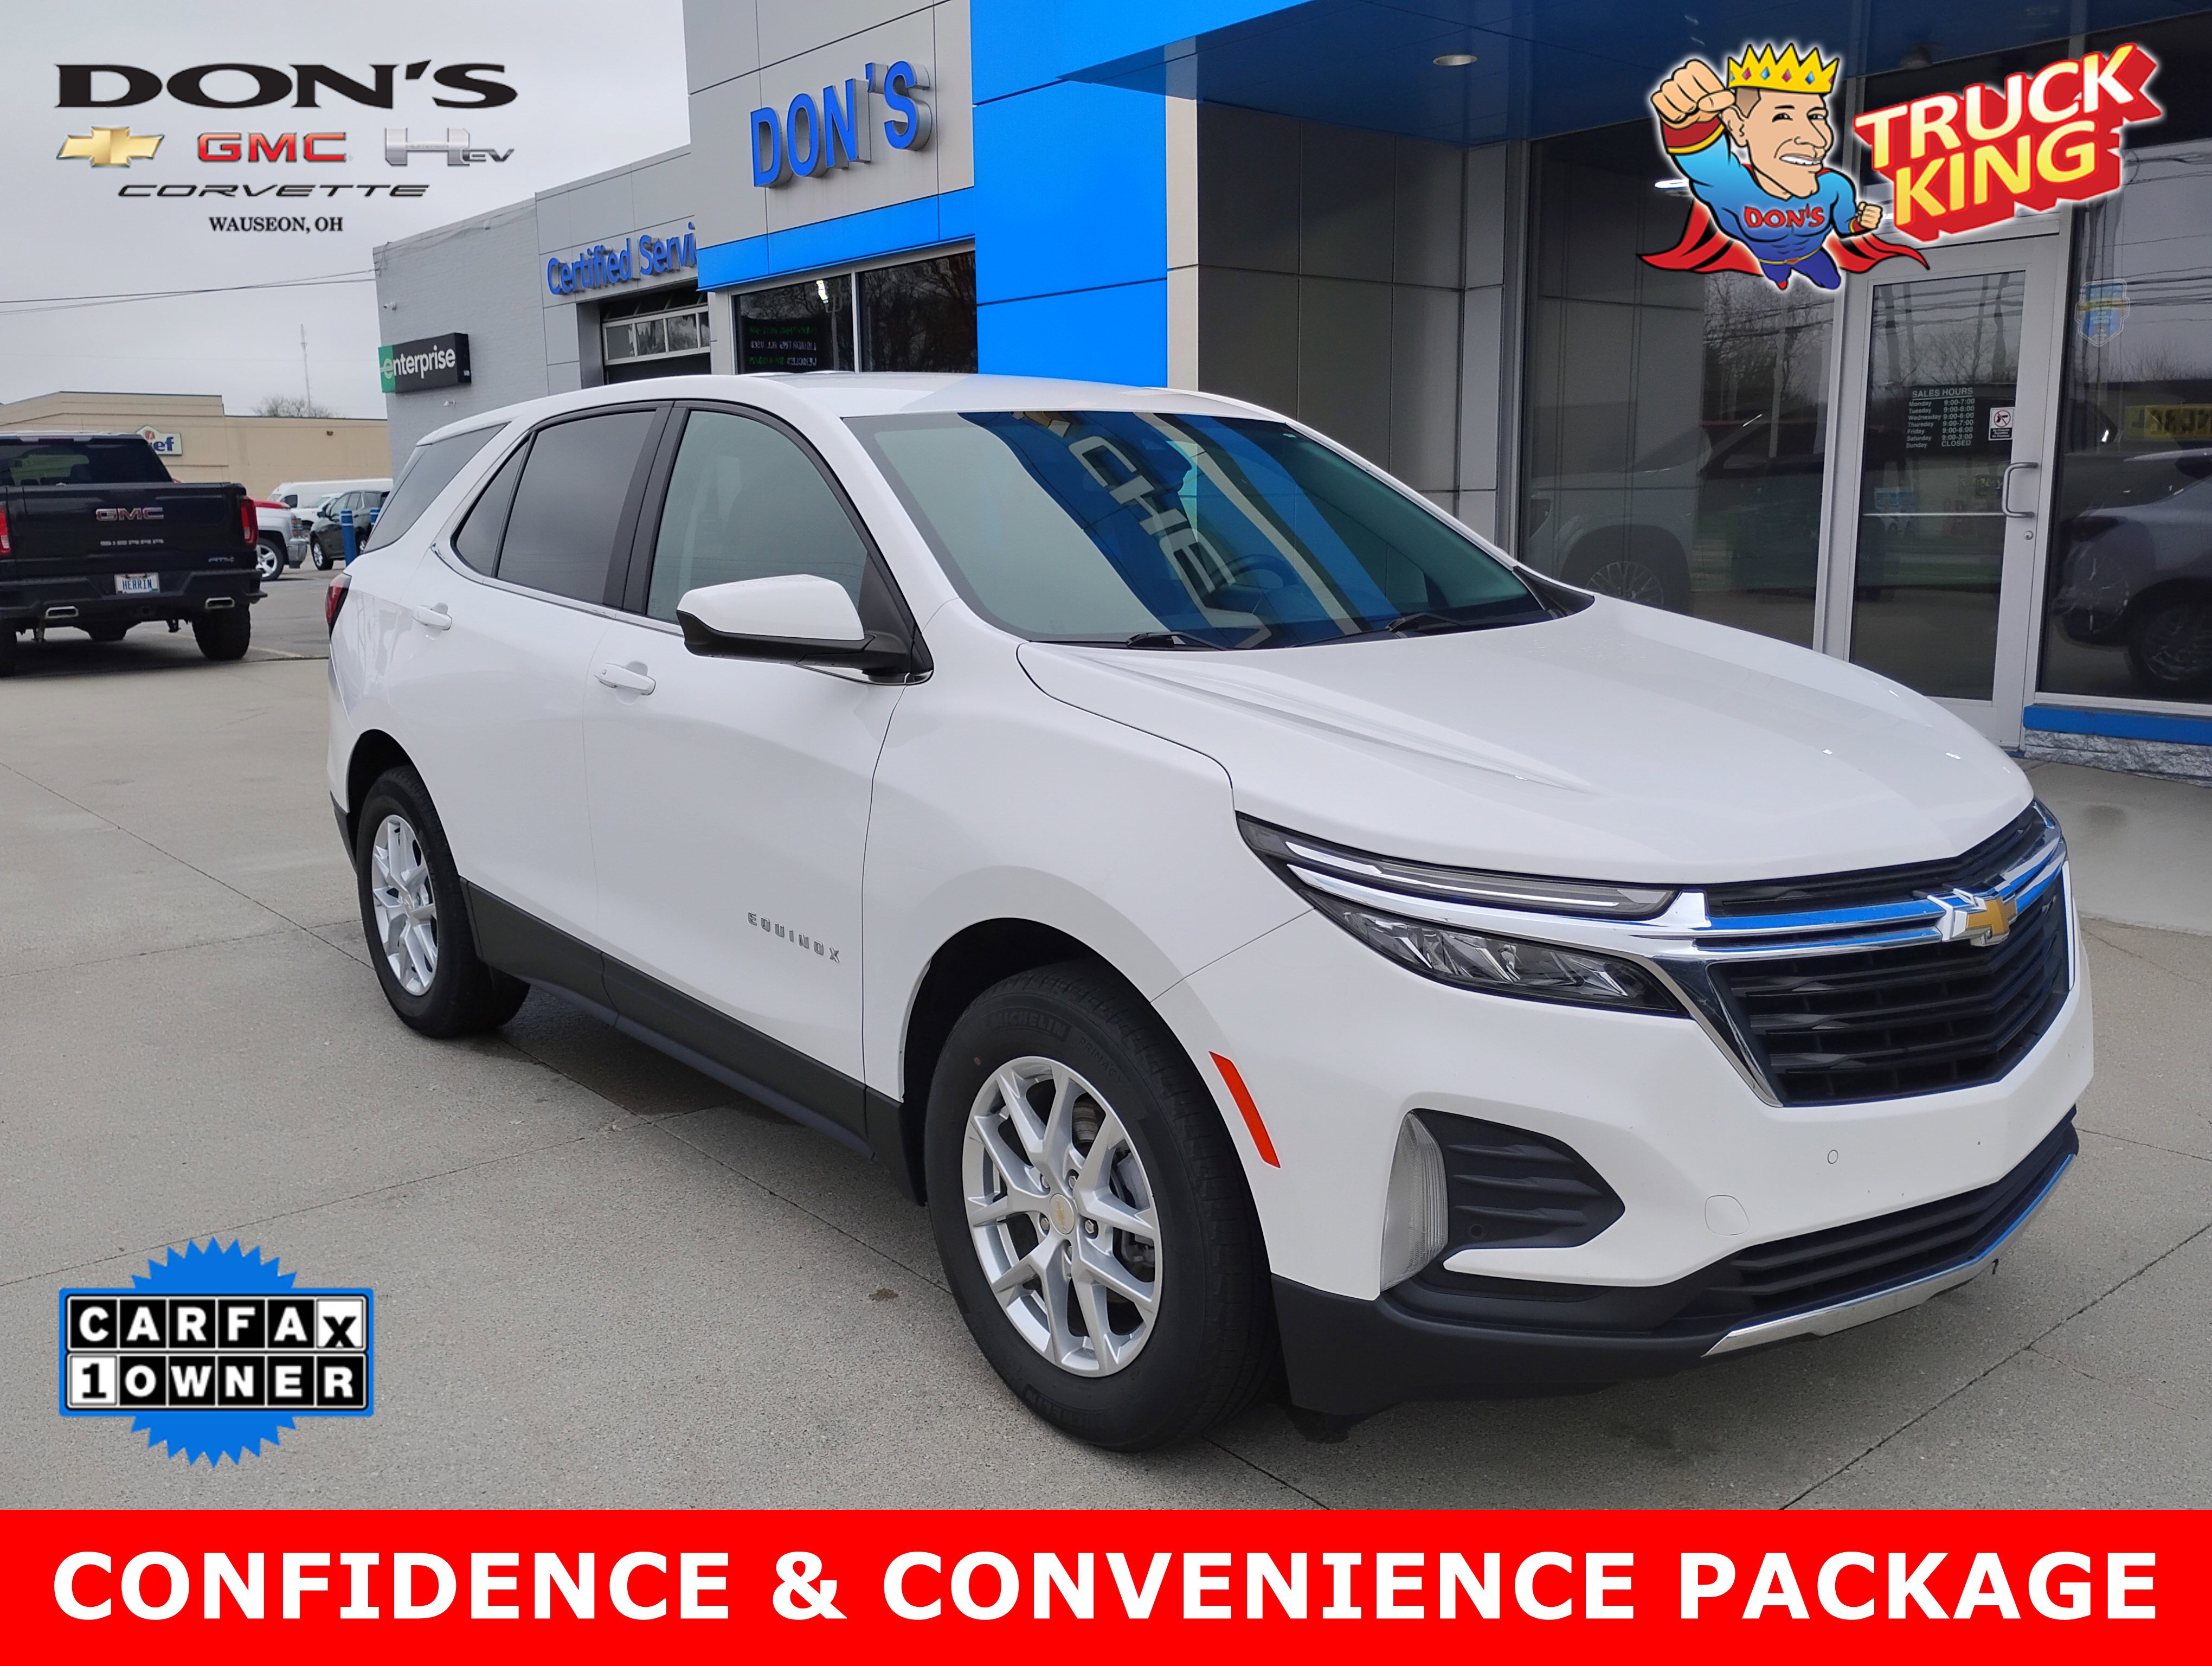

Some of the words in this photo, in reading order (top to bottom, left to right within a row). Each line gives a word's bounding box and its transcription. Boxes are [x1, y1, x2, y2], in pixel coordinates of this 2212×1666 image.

[750, 61, 932, 188] DON'S
[548, 238, 632, 294] Certified
[639, 221, 697, 275] Servi
[381, 345, 456, 379] enterprise
[1912, 389, 1940, 398] SALES
[1943, 388, 1973, 396] HOURS
[151, 436, 174, 452] ef
[95, 507, 164, 521] GMC
[122, 579, 152, 591] HERRIN
[748, 911, 840, 964] EQUINOX
[989, 1010, 1068, 1038] MICHELIN
[1077, 1036, 1129, 1085] PRIMACY
